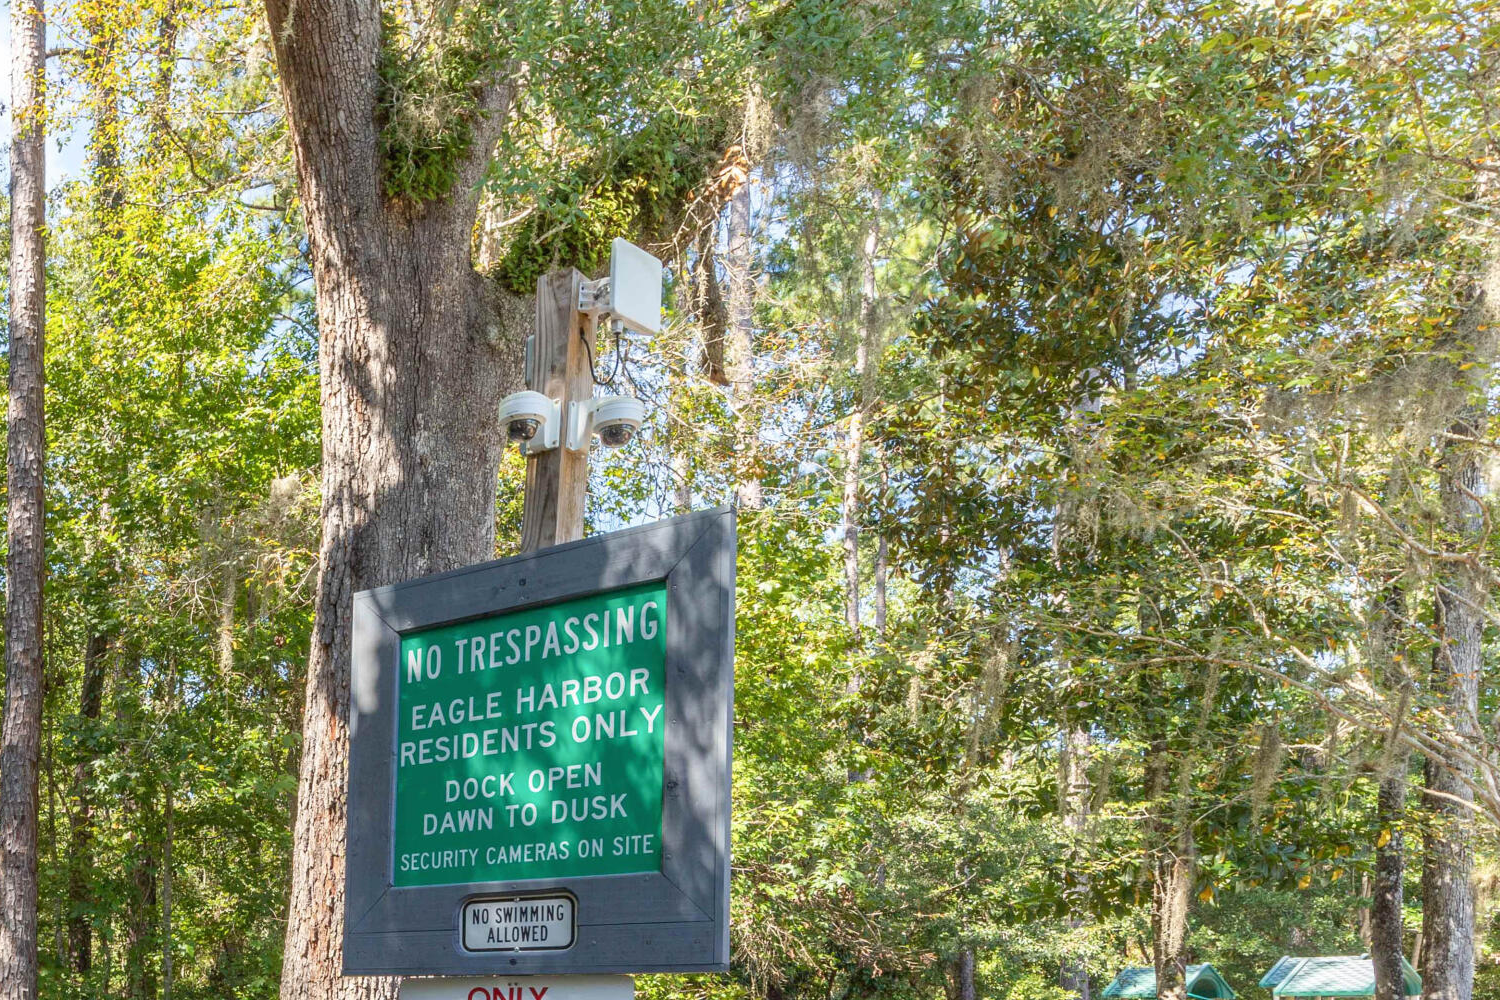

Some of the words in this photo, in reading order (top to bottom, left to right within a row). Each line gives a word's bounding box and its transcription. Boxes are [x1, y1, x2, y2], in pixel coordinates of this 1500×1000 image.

[407, 645, 442, 683] NO
[455, 601, 658, 674] TRESPASSING
[411, 692, 502, 730] EAGLE
[516, 668, 650, 714] HARBOR
[400, 721, 557, 767] RESIDENTS
[571, 704, 663, 744] ONLY
[446, 772, 516, 802] DOCK
[528, 763, 602, 794] OPEN
[423, 807, 493, 836] DAWN
[505, 803, 537, 828] TO
[552, 794, 628, 824] DUSK
[401, 848, 478, 872] SECURITY
[486, 841, 570, 864] CAMERAS
[578, 838, 603, 858] ON
[613, 834, 654, 855] SITE
[472, 909, 490, 924] NO
[495, 904, 564, 923] SWIMMING
[487, 926, 548, 943] ALLOWED
